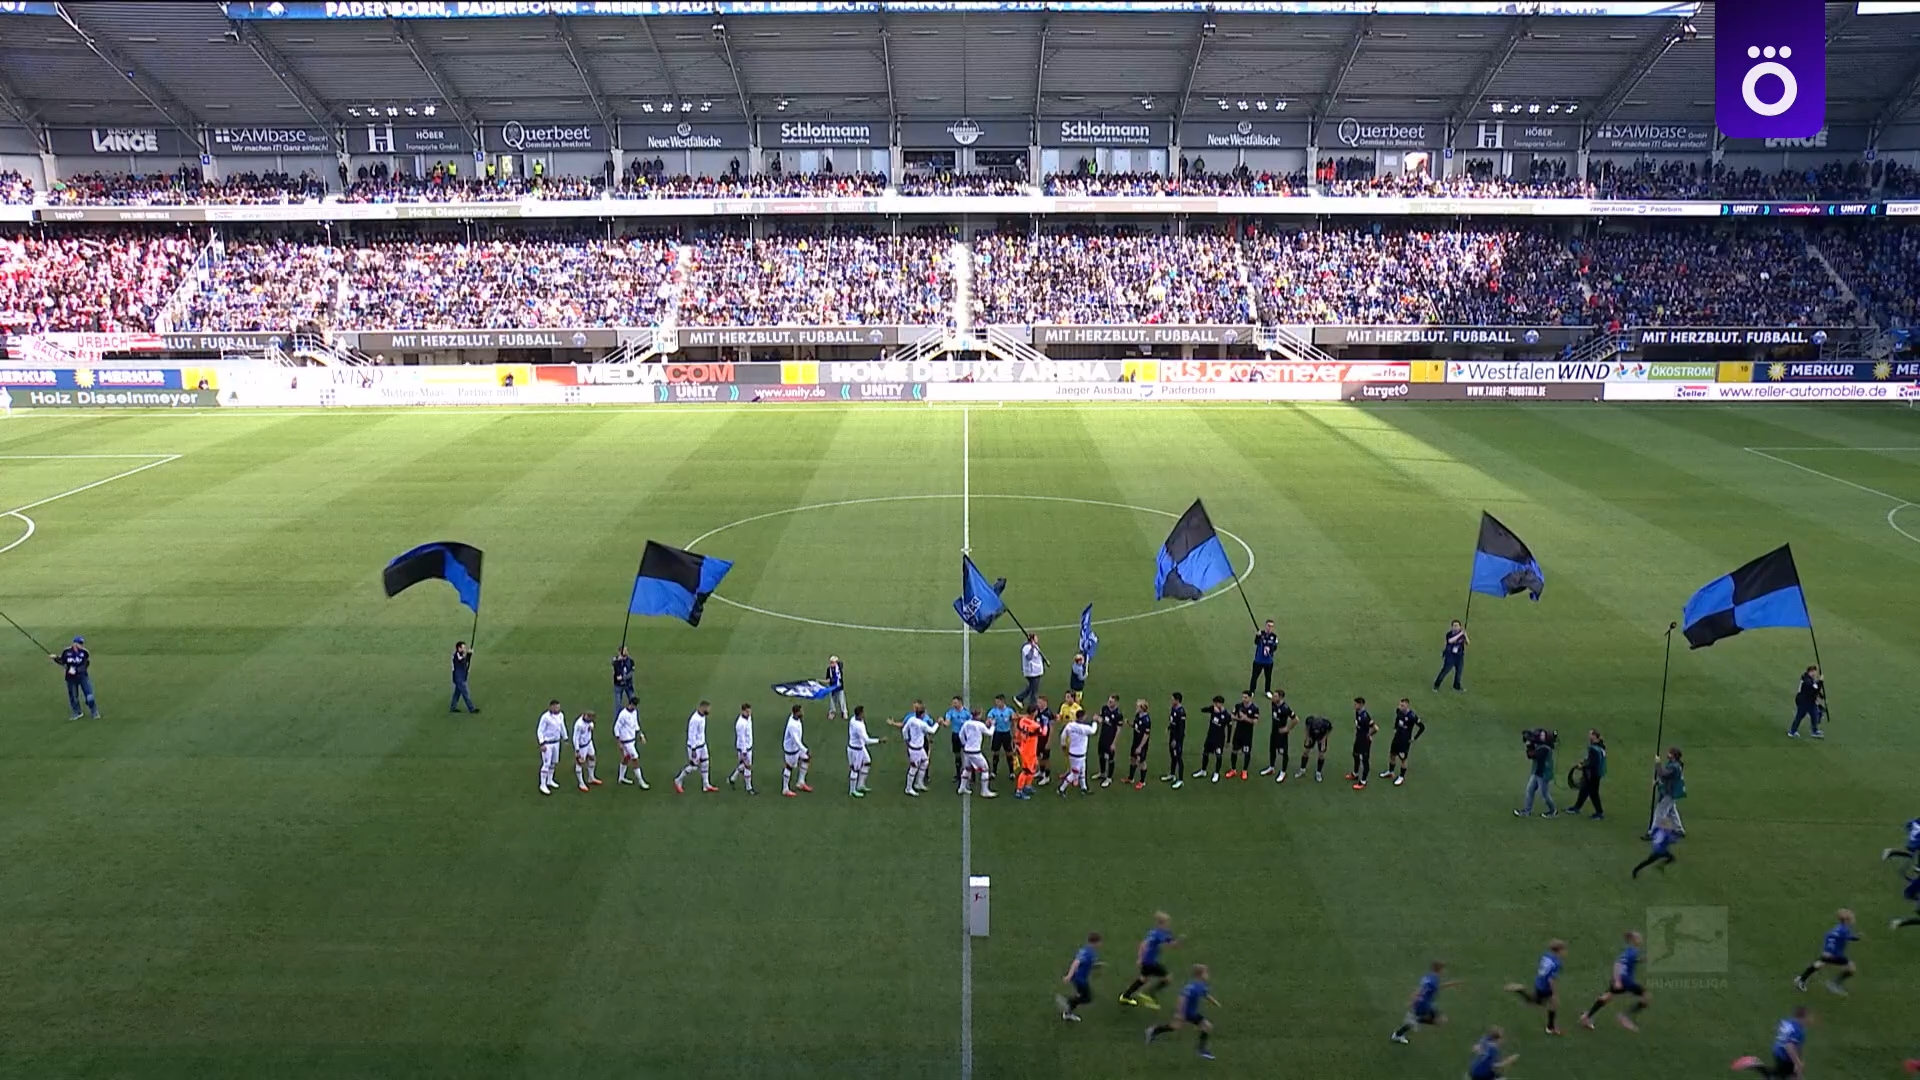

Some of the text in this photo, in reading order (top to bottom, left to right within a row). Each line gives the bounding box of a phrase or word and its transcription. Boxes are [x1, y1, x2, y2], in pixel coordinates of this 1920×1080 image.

[457, 1, 577, 15] PADERBORN
[230, 127, 306, 143] SAMbase
[502, 121, 591, 151] Querbeet
[780, 123, 871, 138] Schlotmann
[1060, 122, 1150, 137] Schlotmann
[1338, 118, 1426, 148] Querbeet
[1611, 123, 1687, 139] SAMbase
[91, 129, 159, 153] LANGE
[647, 136, 669, 148] Neue
[1206, 134, 1229, 147] Neue
[408, 207, 432, 218] Holz
[1650, 205, 1683, 213] Paderborn
[1731, 205, 1759, 214] UNITY
[1778, 205, 1820, 215] www.unity.de
[1839, 204, 1867, 214] UNITY
[391, 334, 563, 347] MIT HERZBLUT. FUßBALL.
[689, 330, 864, 344] MIT HERZBLUT. FUßBALL.
[1044, 329, 1219, 342] MIT HERZBLUT. FUßBALL.
[1345, 330, 1516, 343] MIT HERZBLUT. FUßBALL.
[1641, 331, 1809, 344] MIT HERZBLUT. FUßBALL.
[830, 363, 909, 383] HOME
[1019, 363, 1112, 383] ARENA
[1651, 365, 1716, 378] ÖKOSTROM!
[1740, 365, 1749, 374] 10
[1789, 364, 1855, 378] MERKUR
[0, 370, 57, 384] ERKUR
[97, 370, 166, 384] MERKUR
[675, 385, 720, 399] UNITY
[754, 385, 827, 400] www.unity.de
[860, 384, 905, 397] UNITY
[1055, 385, 1216, 397] Jaeger Ausbau Paderborn
[1719, 384, 1888, 398] www.reller-automobile.de
[30, 391, 72, 405] Holz
